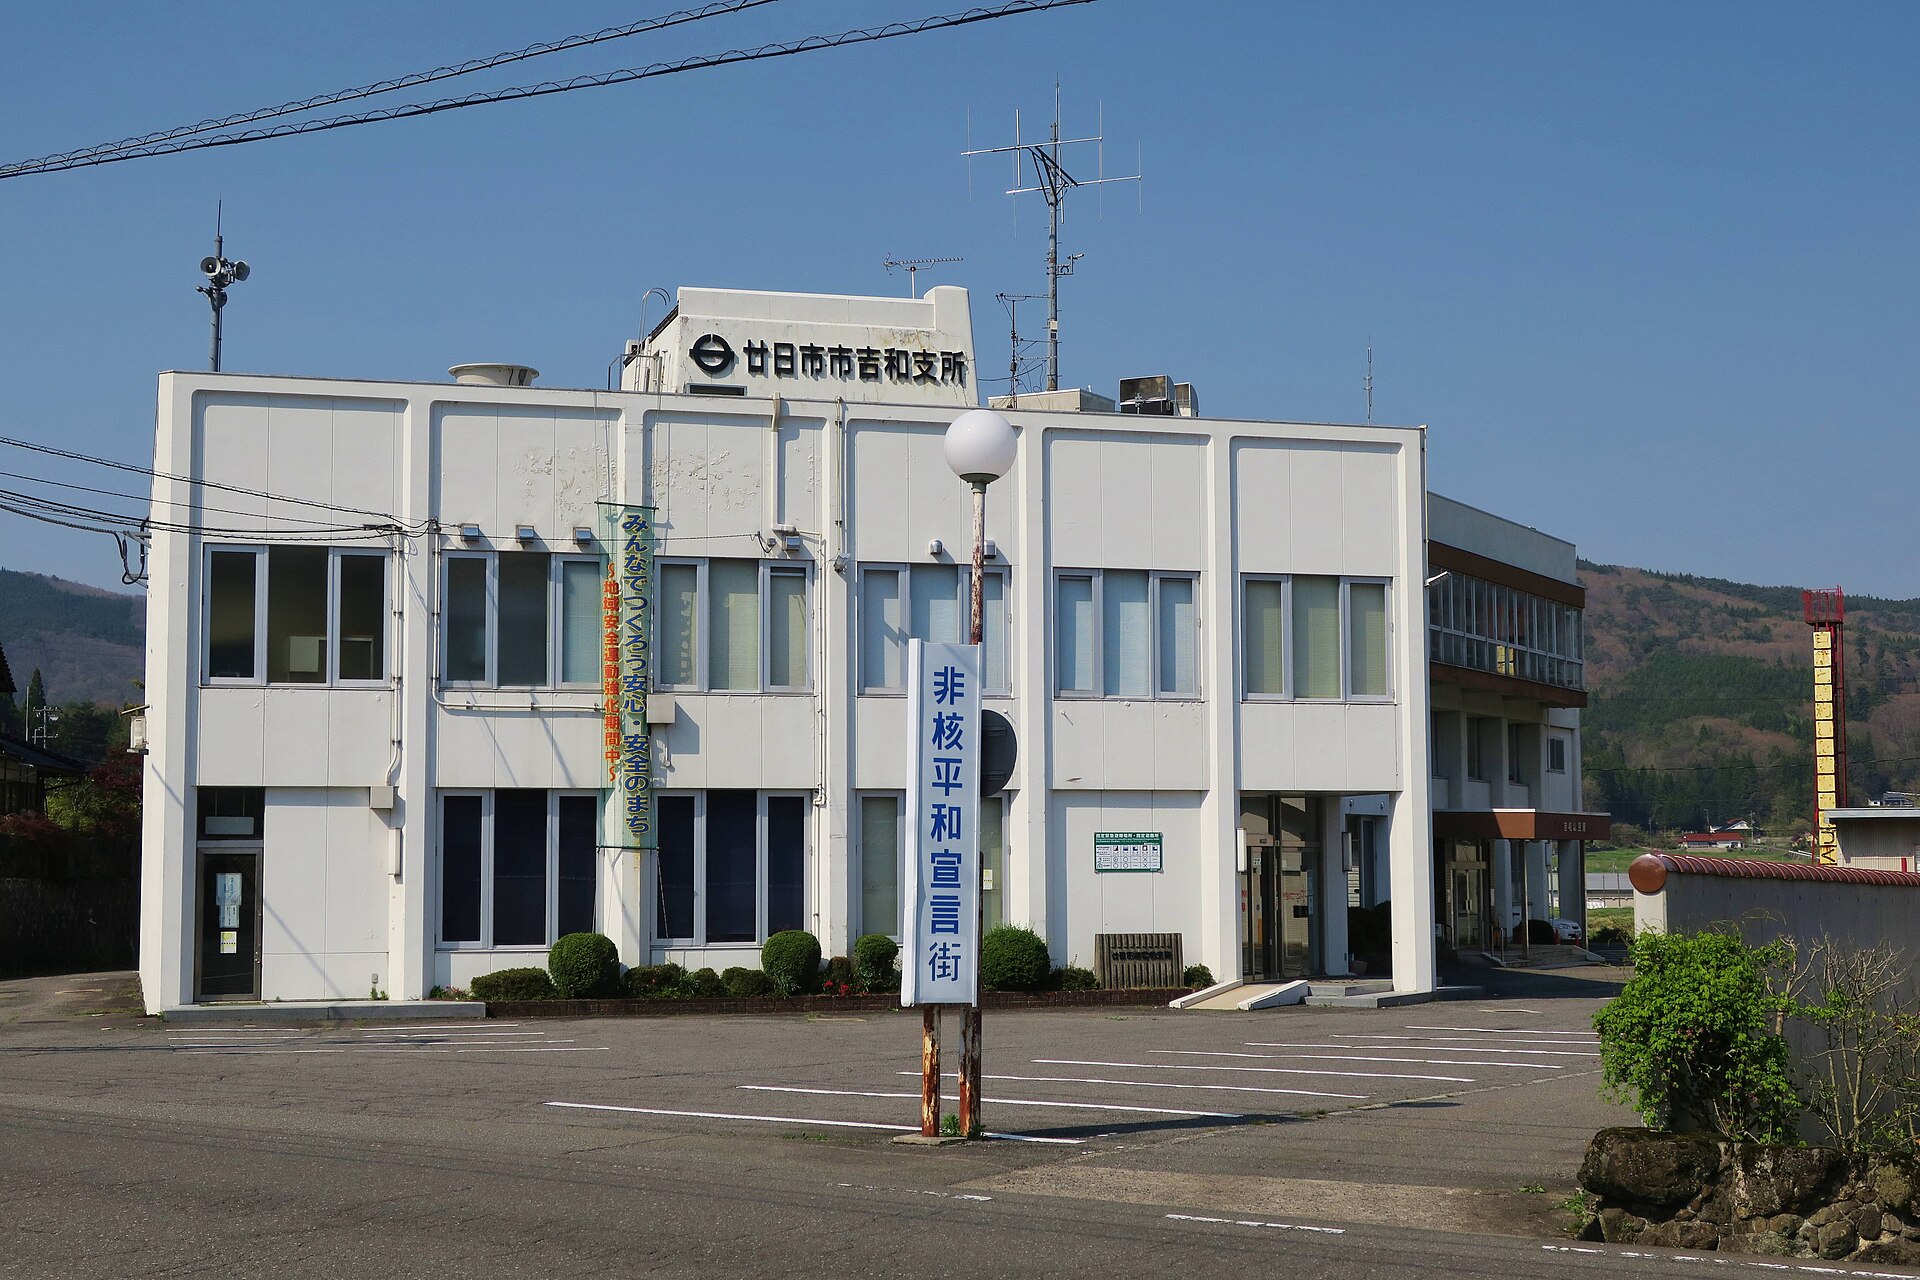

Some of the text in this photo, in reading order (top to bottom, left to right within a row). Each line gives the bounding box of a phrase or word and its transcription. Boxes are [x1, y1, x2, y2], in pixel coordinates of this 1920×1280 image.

[742, 339, 965, 388] 廿日市市吉和支所
[928, 666, 965, 982] 非核平和宣言街
